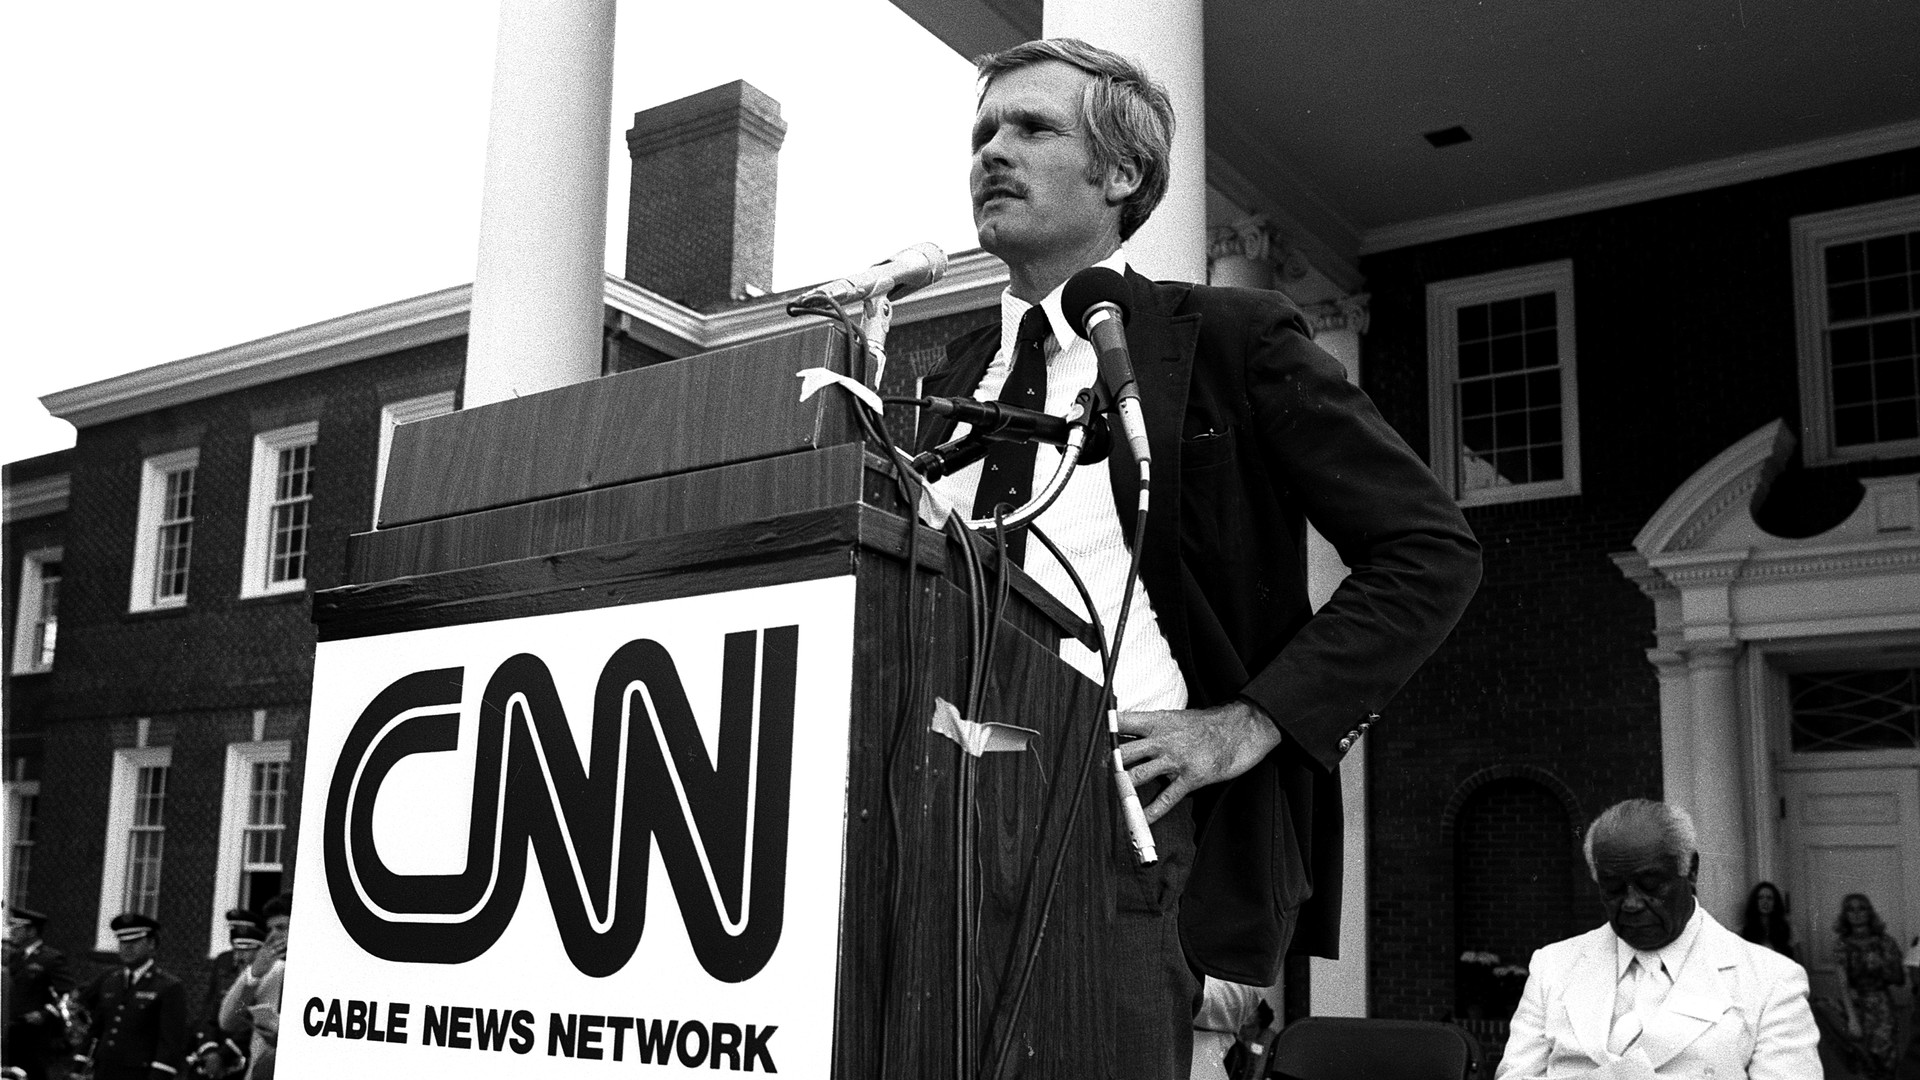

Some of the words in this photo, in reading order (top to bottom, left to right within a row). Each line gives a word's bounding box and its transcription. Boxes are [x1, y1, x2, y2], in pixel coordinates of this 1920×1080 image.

[323, 624, 799, 984] CNN
[303, 996, 411, 1044] CABLE
[422, 1004, 535, 1055] NEWS
[547, 1012, 779, 1074] NETWORK
